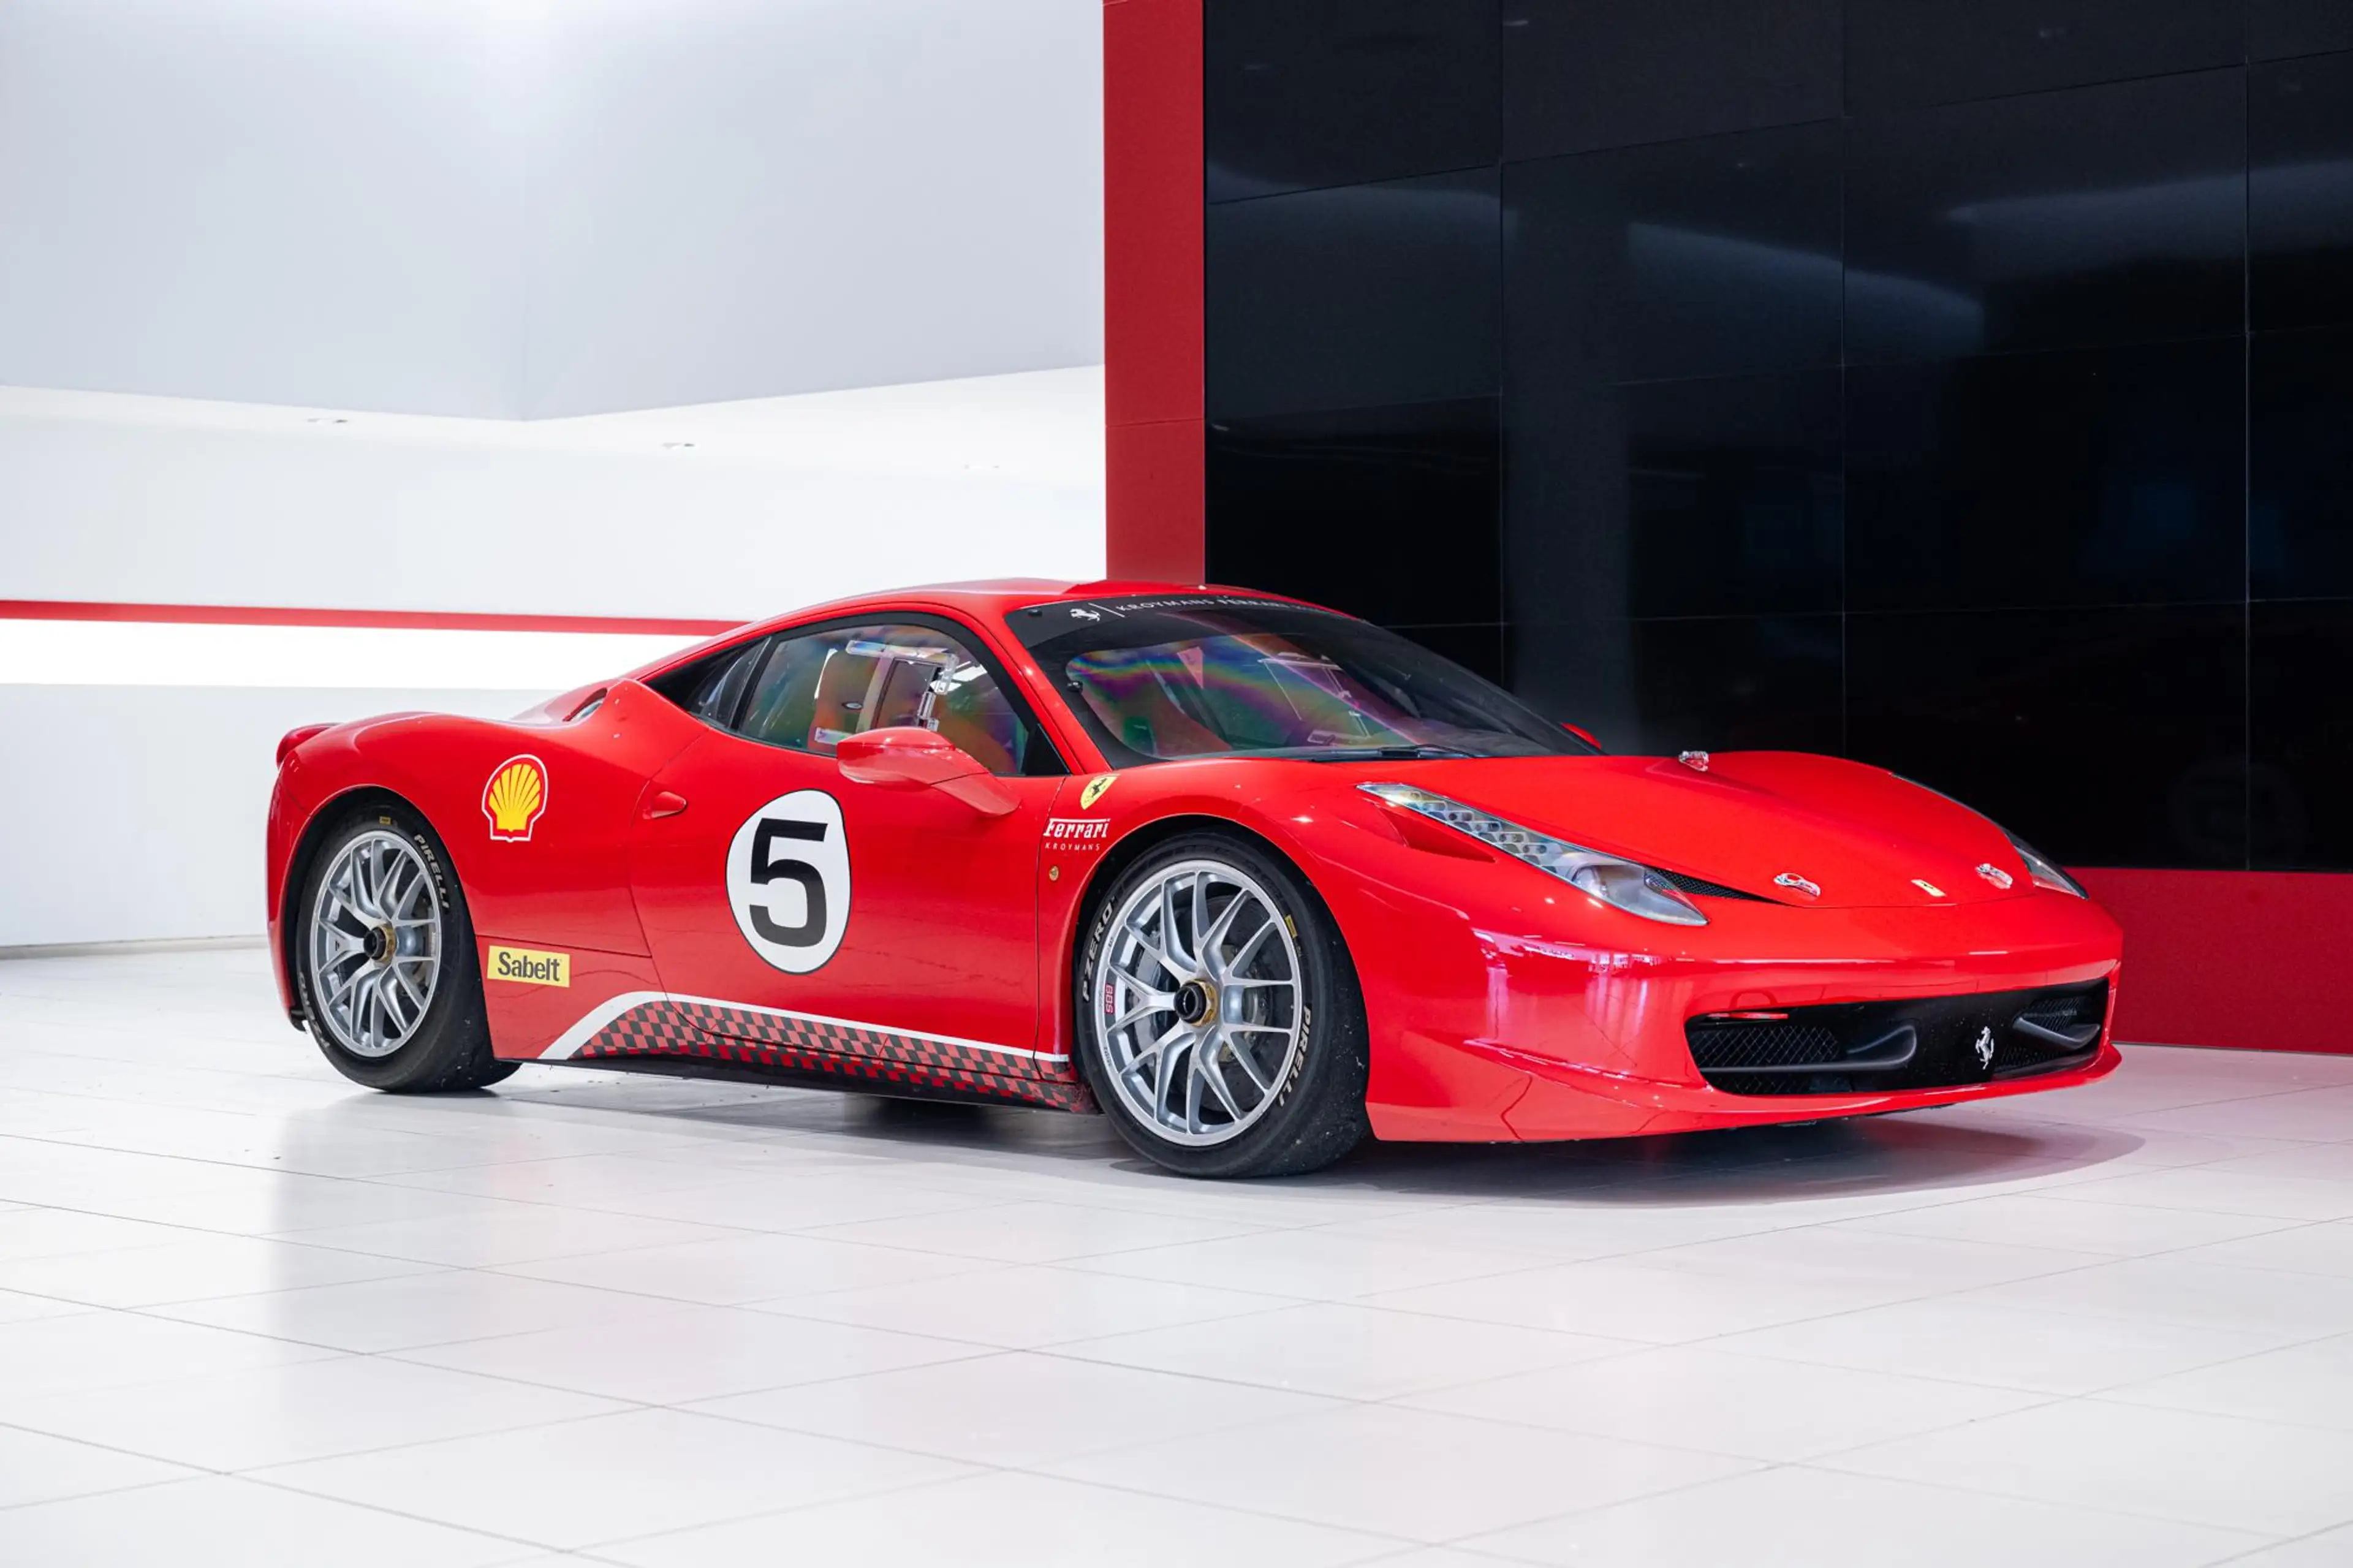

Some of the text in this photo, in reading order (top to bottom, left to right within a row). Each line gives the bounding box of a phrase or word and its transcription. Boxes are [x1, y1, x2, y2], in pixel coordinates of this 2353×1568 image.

[1043, 817, 1111, 838] Ferrari
[1045, 842, 1101, 850] KROYMANS
[414, 834, 450, 909] PIRELLI
[749, 817, 828, 947] 5
[498, 952, 560, 982] Sabelt
[1279, 1005, 1311, 1107] PIRELLI
